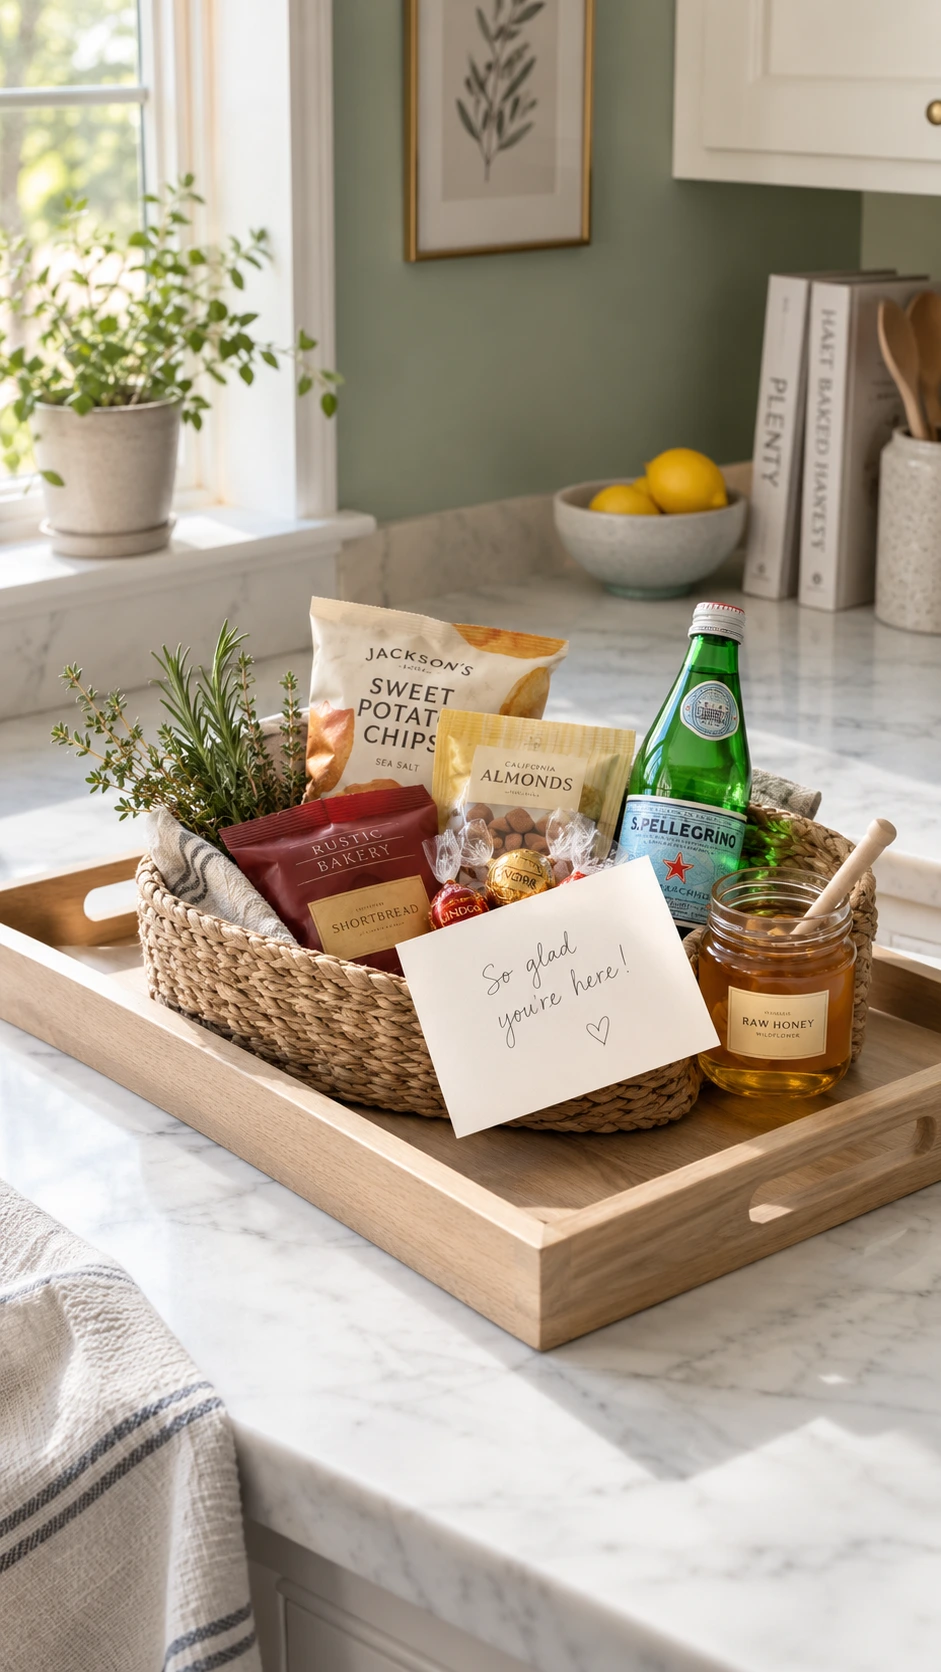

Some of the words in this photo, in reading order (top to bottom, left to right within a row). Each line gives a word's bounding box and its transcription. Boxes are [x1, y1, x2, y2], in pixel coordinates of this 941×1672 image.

[761, 376, 788, 488] PLENTY
[365, 647, 474, 676] JACKSON'S
[369, 677, 455, 706] SWEET
[357, 698, 440, 728] POTAT
[363, 725, 437, 753] CHIPS
[375, 758, 393, 768] SEA
[396, 761, 420, 773] SALT
[480, 769, 573, 792] ALMONDS
[311, 829, 383, 855] RUSTIC
[317, 844, 390, 873] BAKERY
[331, 903, 419, 935] SHORTBREAD
[482, 963, 514, 996] So
[526, 930, 577, 989] glad
[498, 993, 562, 1049] you're
[742, 1016, 769, 1028] RAW
[773, 1019, 815, 1030] HONEY
